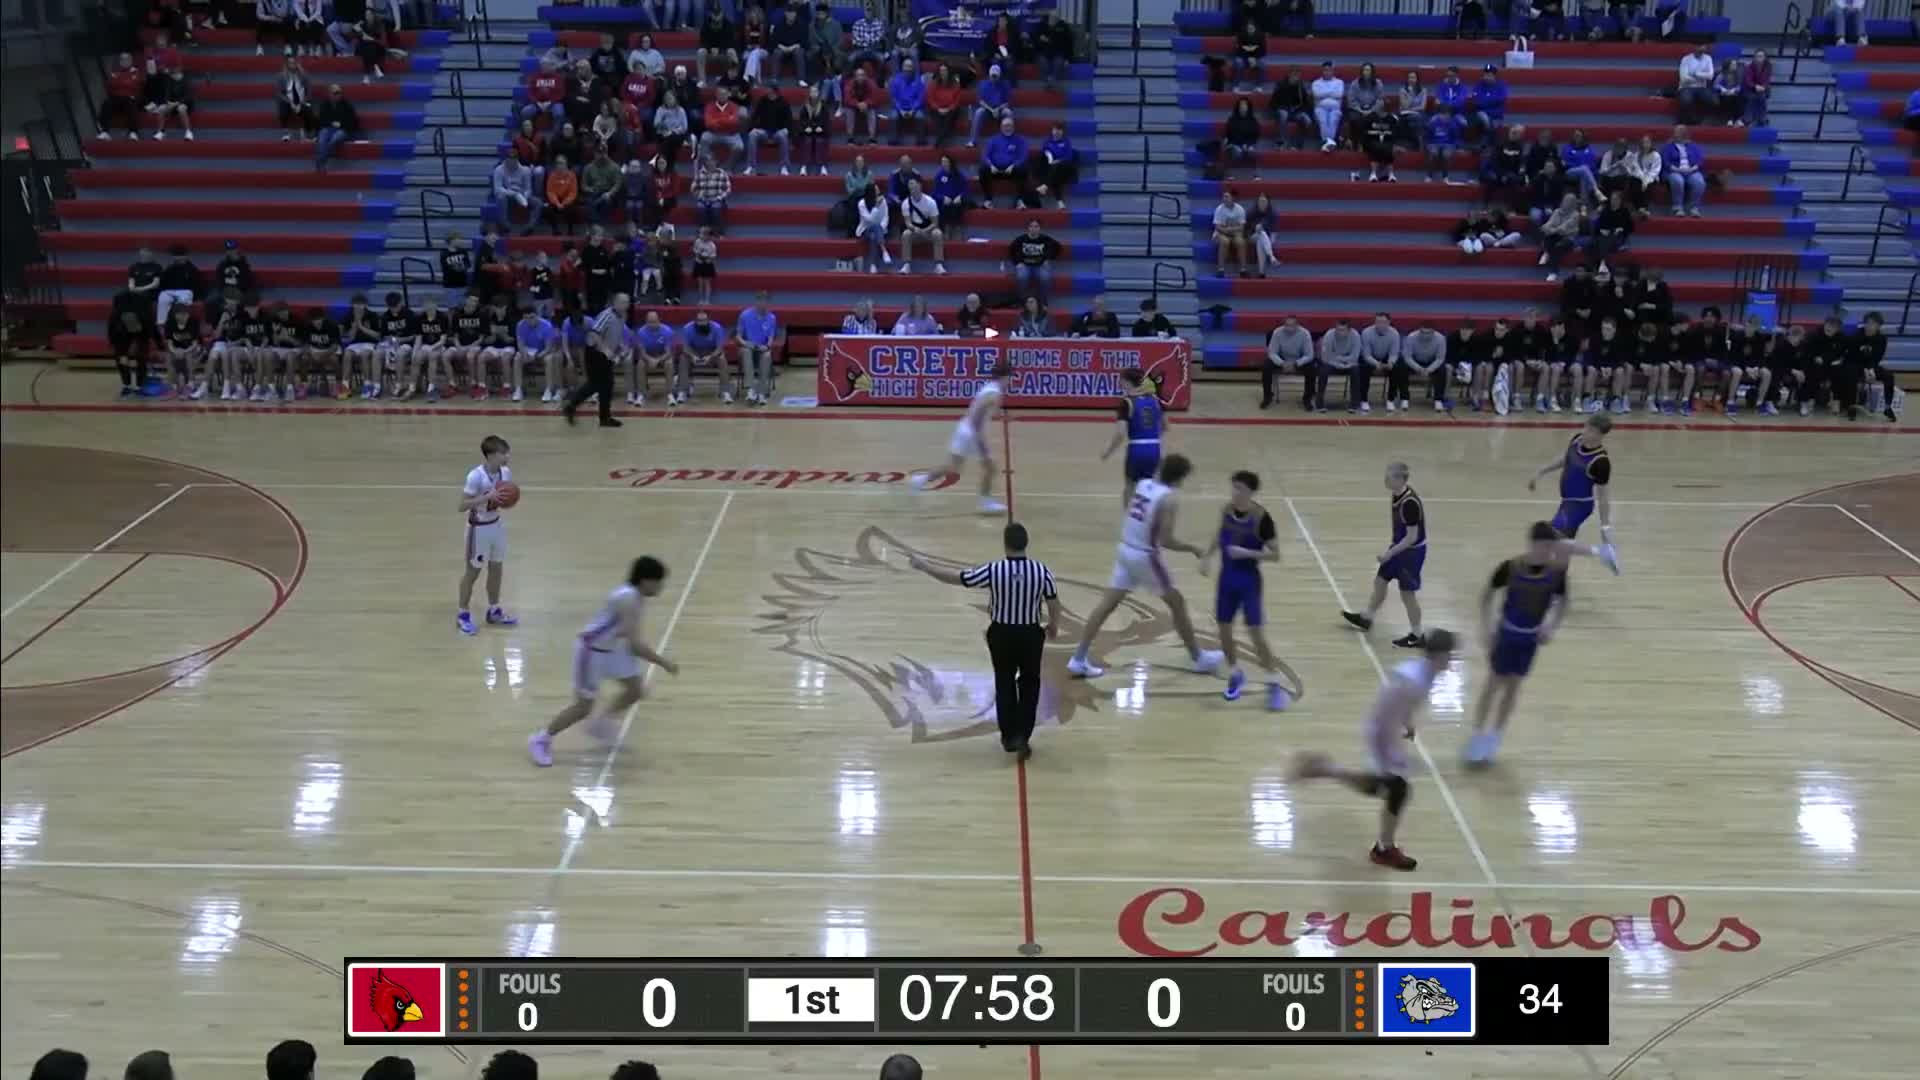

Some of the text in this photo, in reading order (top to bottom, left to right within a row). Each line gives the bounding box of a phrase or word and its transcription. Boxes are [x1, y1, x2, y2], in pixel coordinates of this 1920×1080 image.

[869, 345, 1000, 377] CRETE
[1007, 348, 1141, 370] HOME OF THE
[870, 377, 918, 398] HIGH
[1007, 371, 1128, 397] CARDINAL
[1118, 887, 1762, 957] Cardinals
